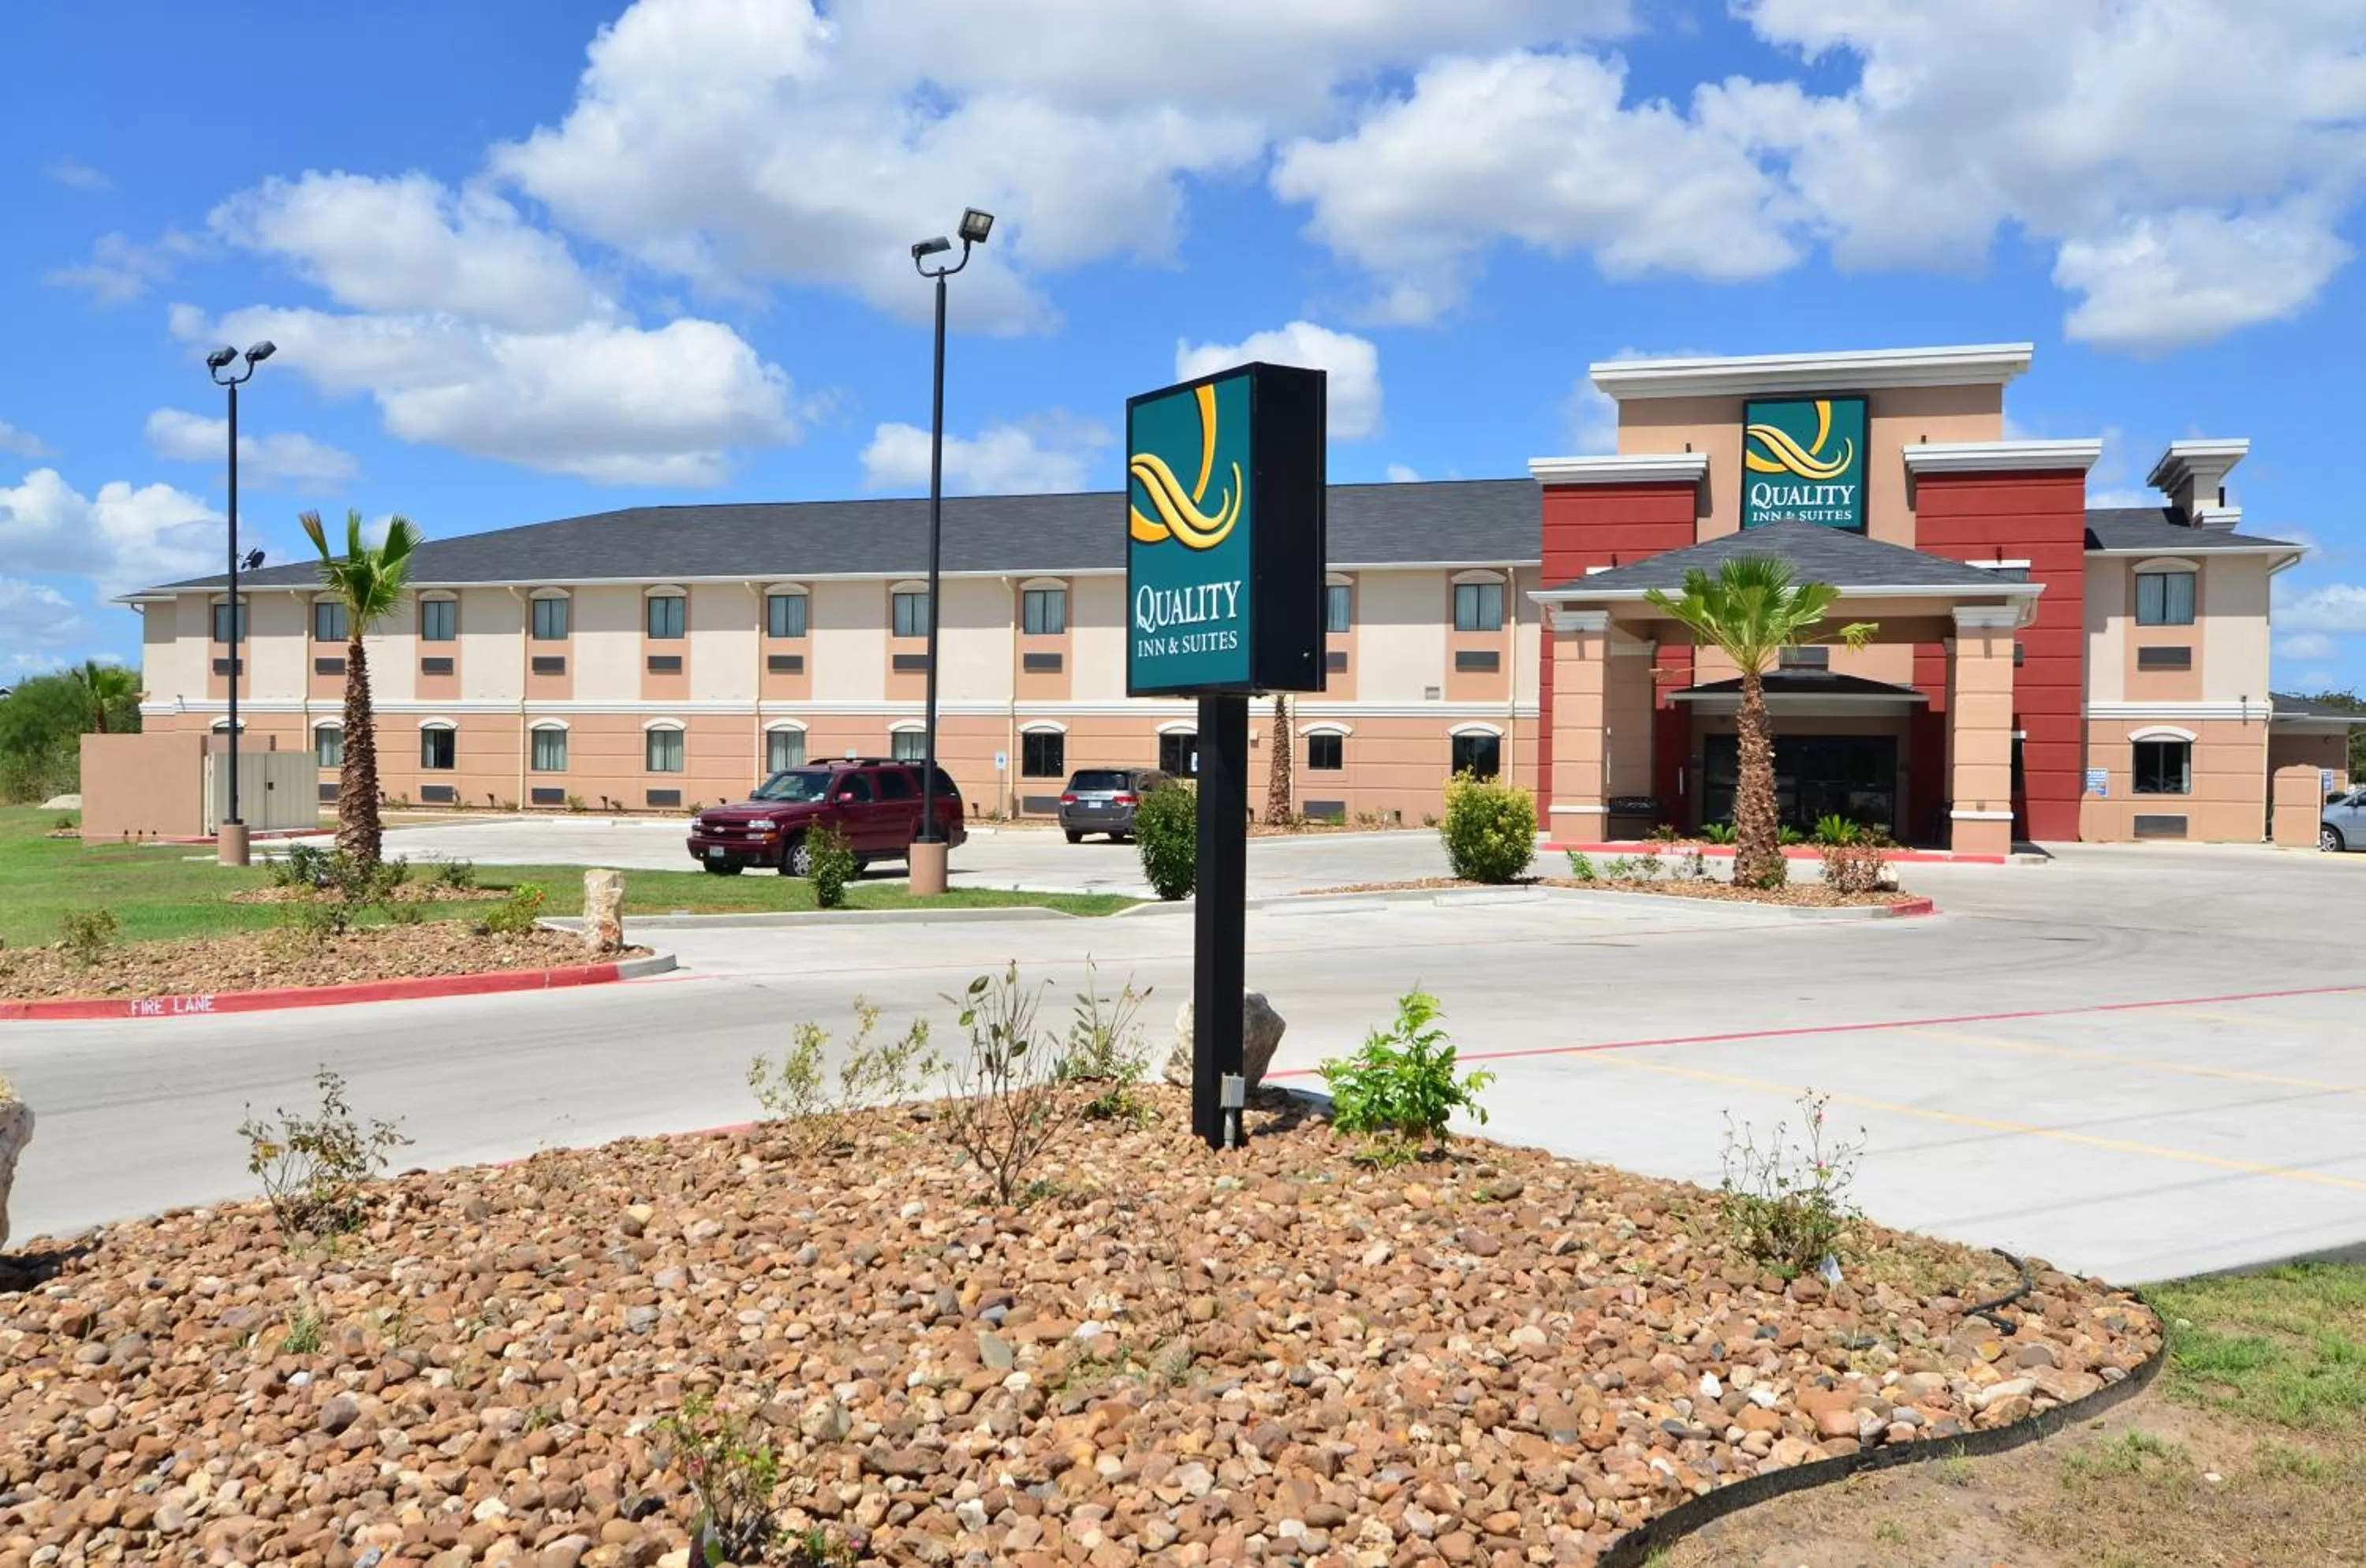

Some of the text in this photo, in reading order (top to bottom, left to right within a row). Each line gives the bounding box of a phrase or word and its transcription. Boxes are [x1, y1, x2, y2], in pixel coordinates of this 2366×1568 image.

[1751, 482, 1855, 509] QUALITY
[1752, 510, 1852, 521] INN & SUITES
[1136, 580, 1241, 633] QUALITY
[1138, 630, 1237, 657] INN & SUITES
[131, 995, 215, 1016] FIRE LANE
